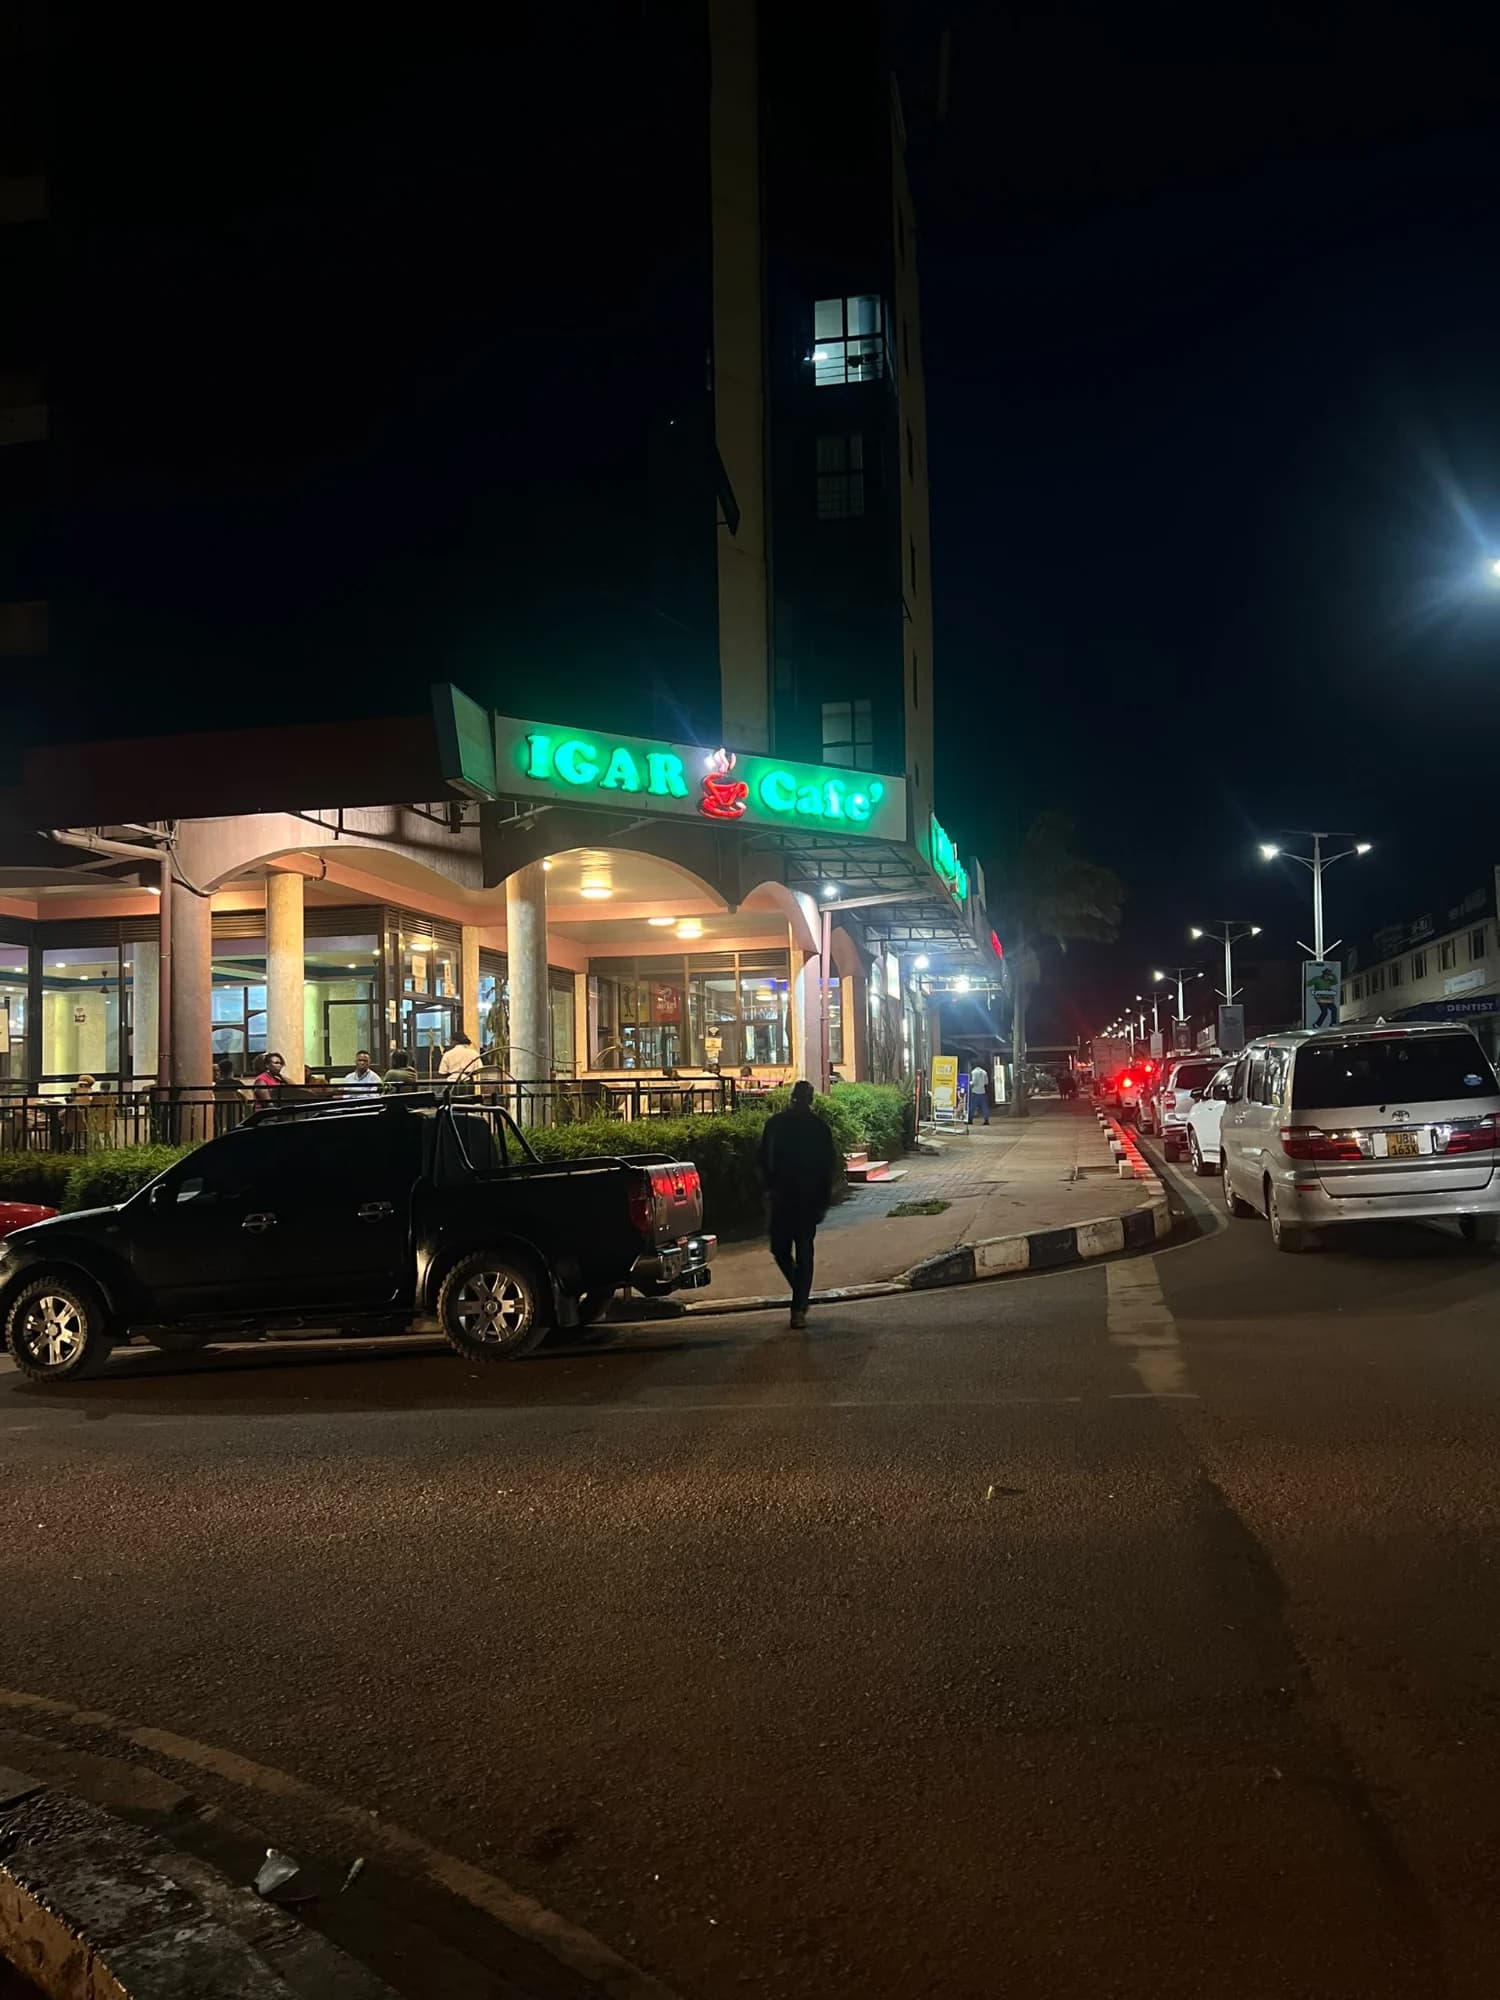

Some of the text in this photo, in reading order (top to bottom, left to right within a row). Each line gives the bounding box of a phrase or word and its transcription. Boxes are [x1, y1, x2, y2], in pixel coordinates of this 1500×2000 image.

[525, 733, 689, 798] IGAR
[1446, 1002, 1494, 1012] DENTIST
[1391, 1144, 1417, 1155] 163X
